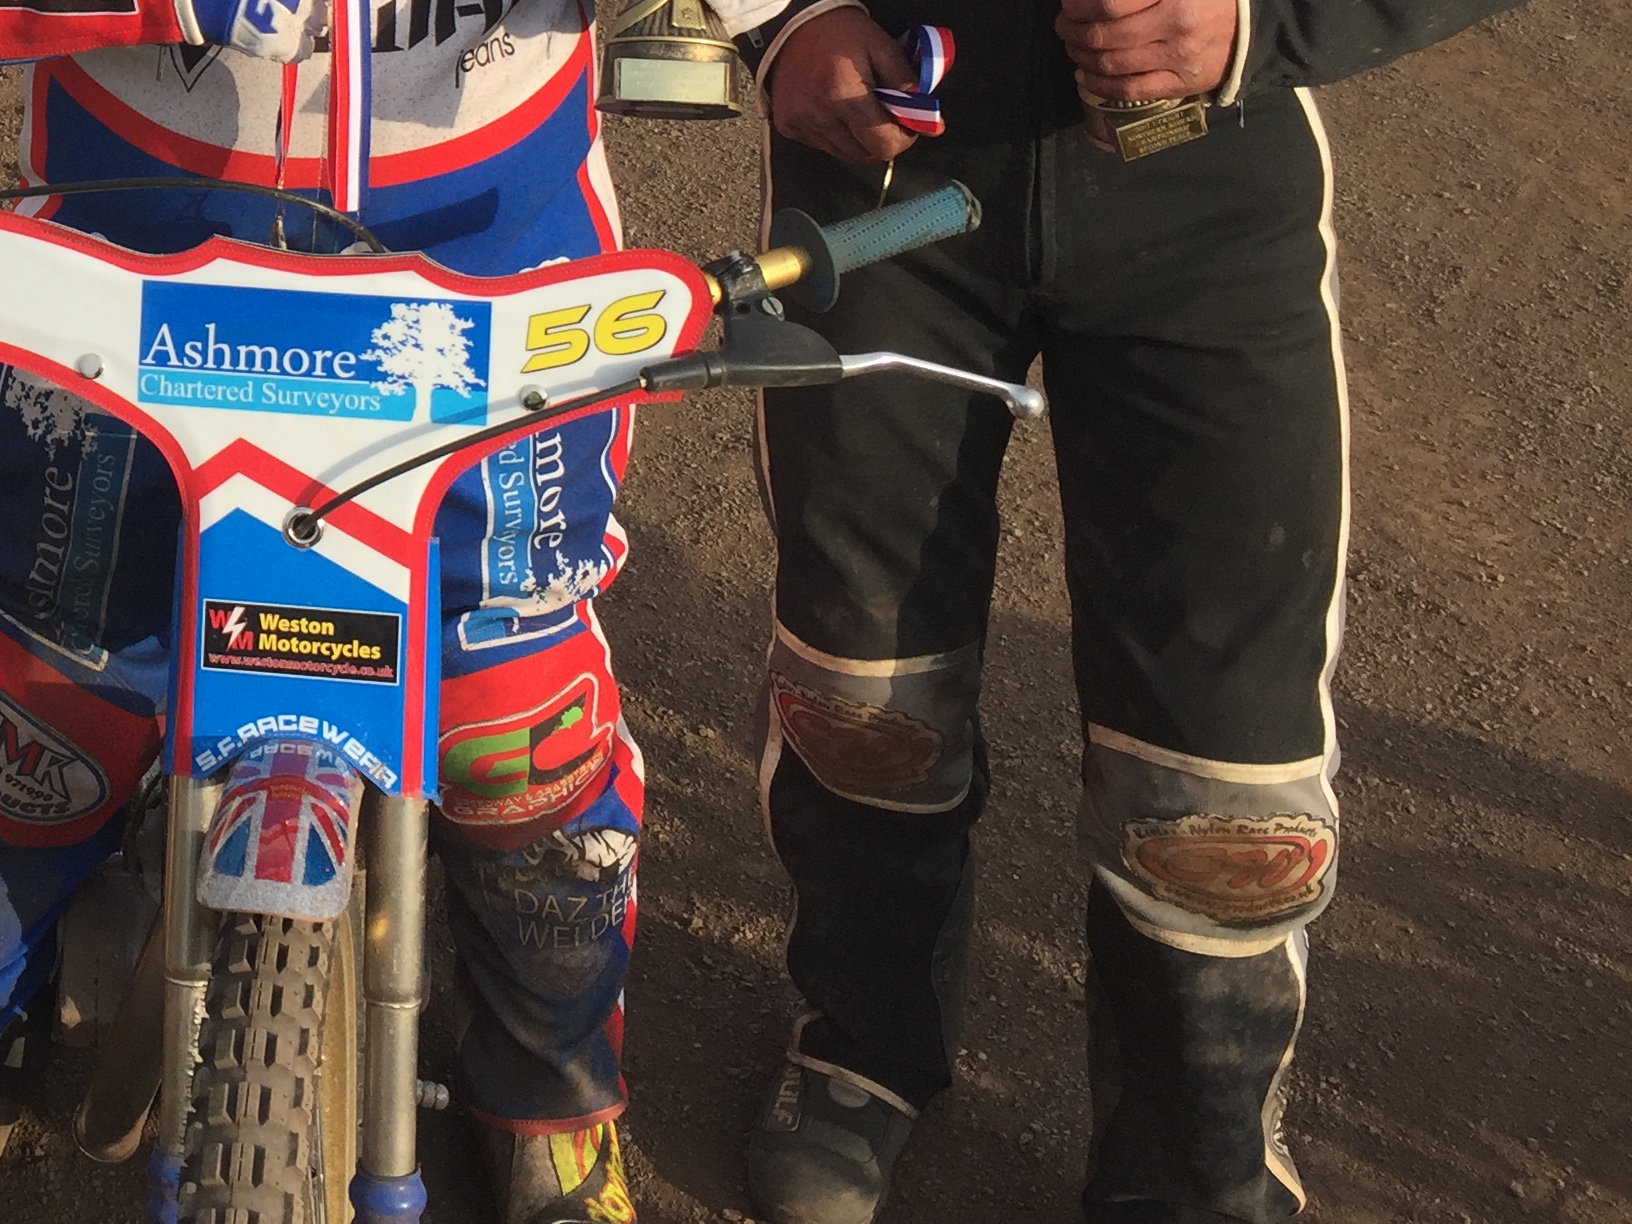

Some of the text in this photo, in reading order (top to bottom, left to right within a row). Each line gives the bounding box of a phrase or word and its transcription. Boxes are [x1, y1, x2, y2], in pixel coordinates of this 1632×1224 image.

[455, 32, 516, 89] jeans
[141, 322, 357, 378] Ashmore
[520, 289, 667, 374] 56
[139, 372, 381, 414] Chartered Surveyors
[533, 431, 567, 550] more
[258, 612, 335, 636] Weston
[258, 633, 382, 661] Motorcycles
[514, 888, 587, 924] DAZ
